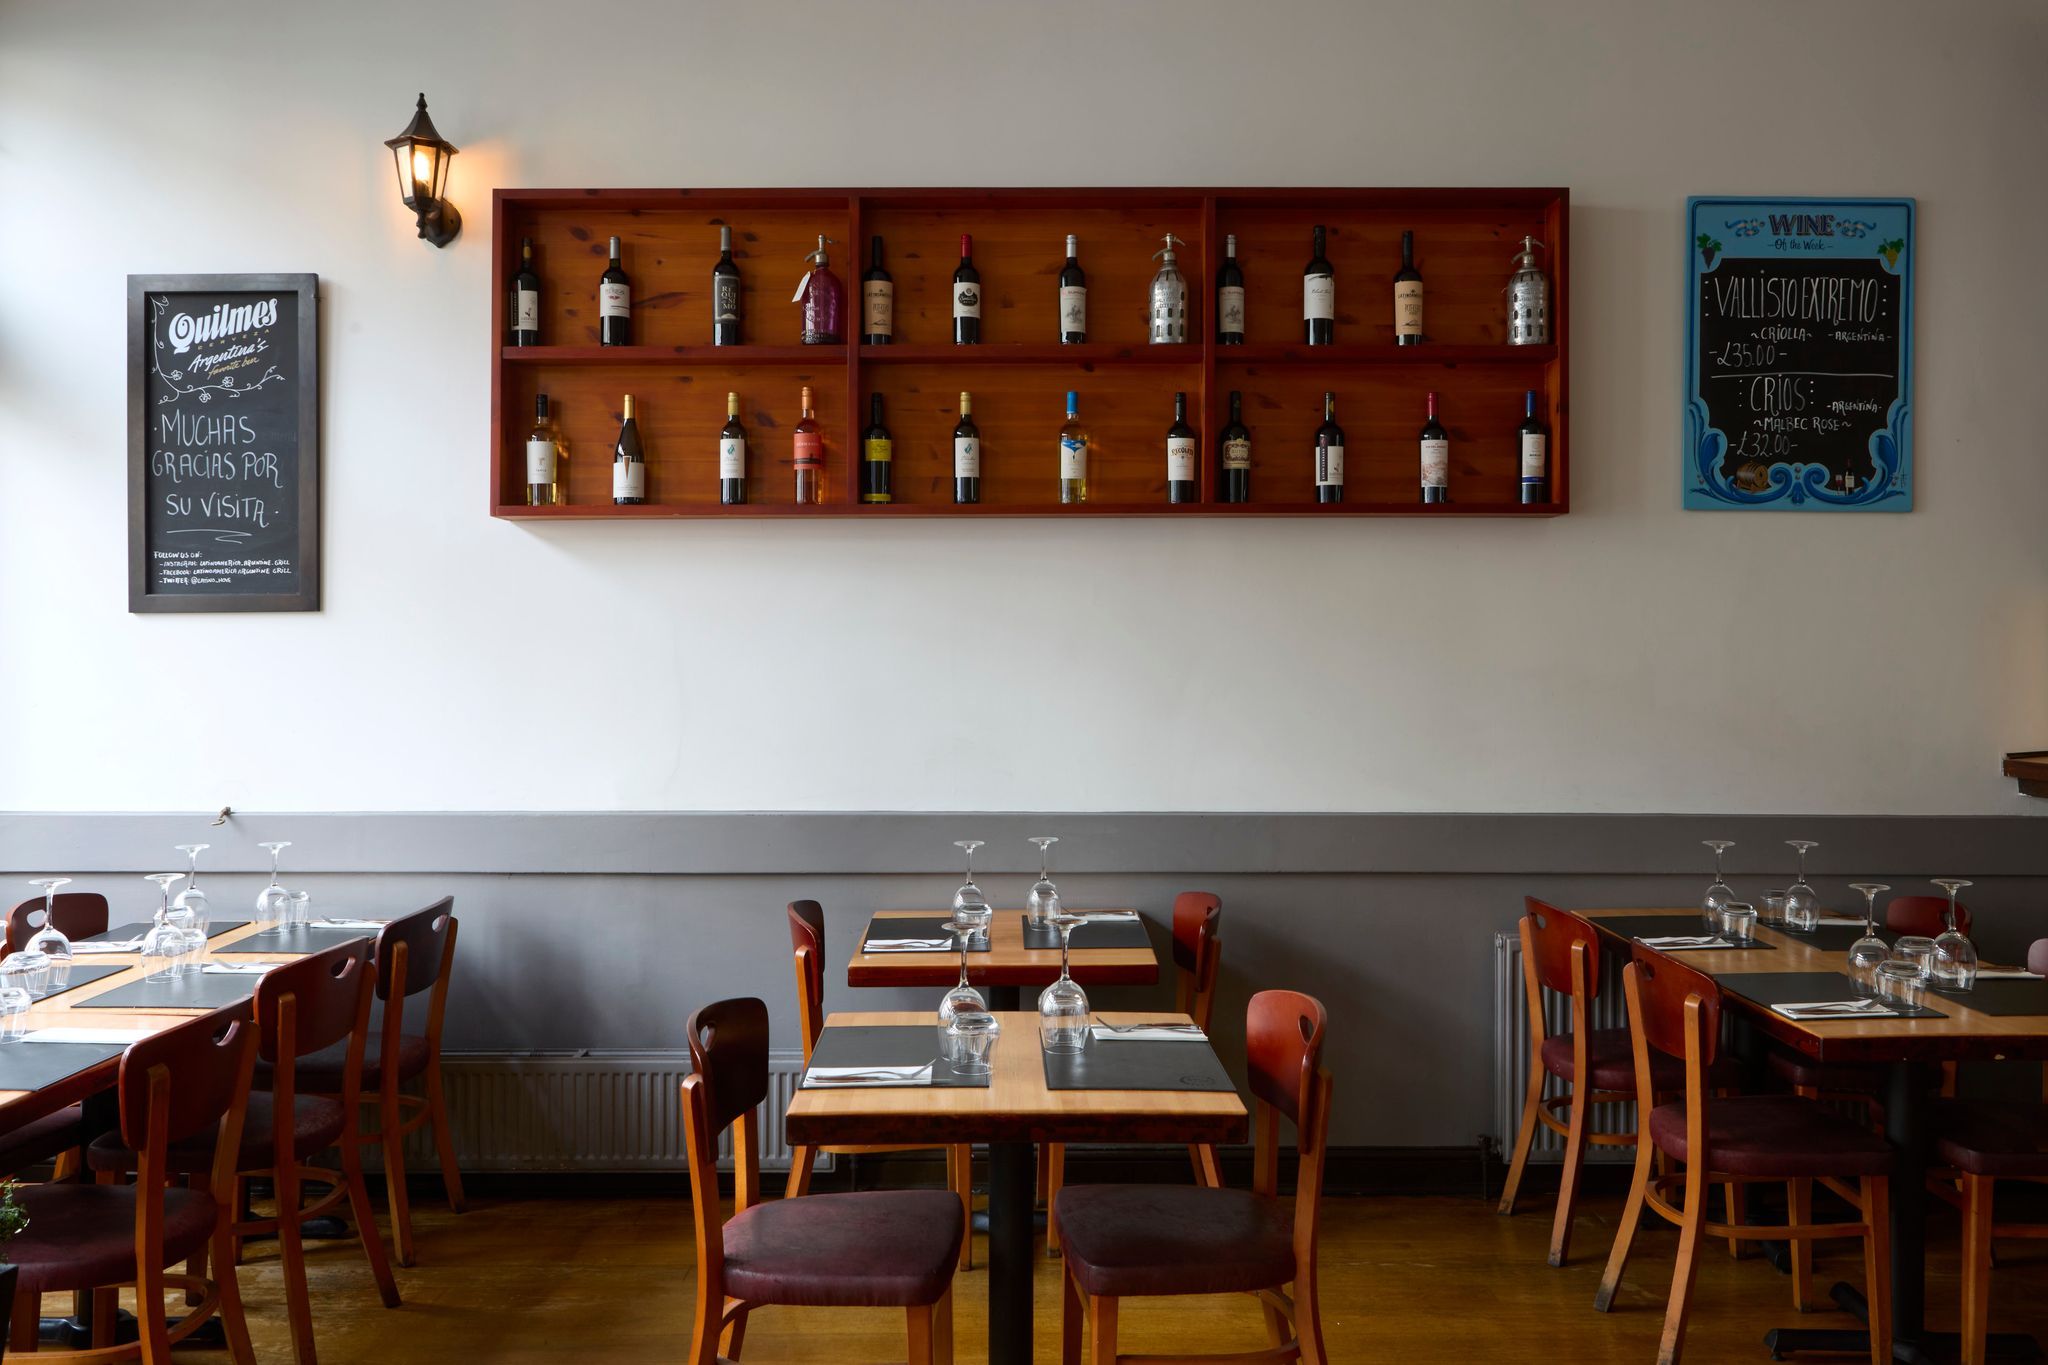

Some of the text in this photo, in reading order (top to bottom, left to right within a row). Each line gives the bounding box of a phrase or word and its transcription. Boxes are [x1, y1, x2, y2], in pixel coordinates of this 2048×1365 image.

[1768, 214, 1835, 237] WINE
[1774, 238, 1826, 251] Of the Week
[1714, 270, 1879, 326] VALLISTO EXTREMO
[168, 298, 278, 354] Quilmes
[188, 338, 269, 374] Argentina's
[1750, 374, 1806, 416] CRIOS
[162, 409, 256, 446] MUCHAS
[1763, 416, 1840, 435] MALBEC ROSE
[152, 450, 283, 488] GRACIAS POR
[166, 492, 270, 527] SU VISITA
[153, 551, 180, 559] FOLLOW
